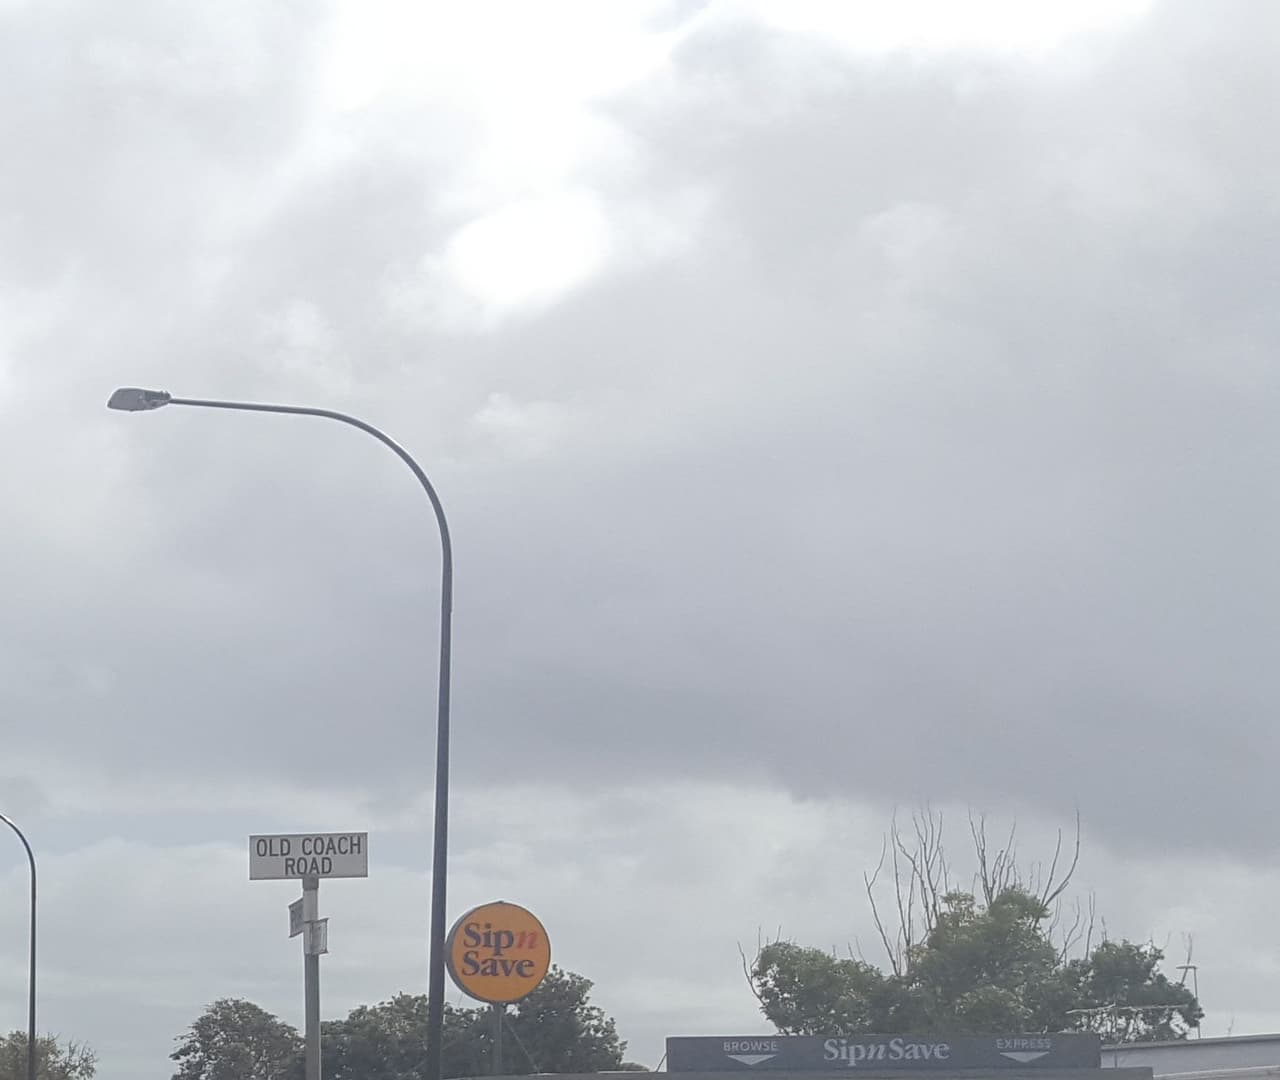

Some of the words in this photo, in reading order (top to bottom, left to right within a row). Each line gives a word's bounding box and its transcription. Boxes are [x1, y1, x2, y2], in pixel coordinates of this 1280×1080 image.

[256, 838, 291, 857] OLD
[302, 836, 361, 855] COACH
[285, 857, 332, 876] ROAD
[462, 950, 535, 978] Save
[723, 1040, 778, 1052] BROWSE
[996, 1038, 1052, 1050] EXPRESS
